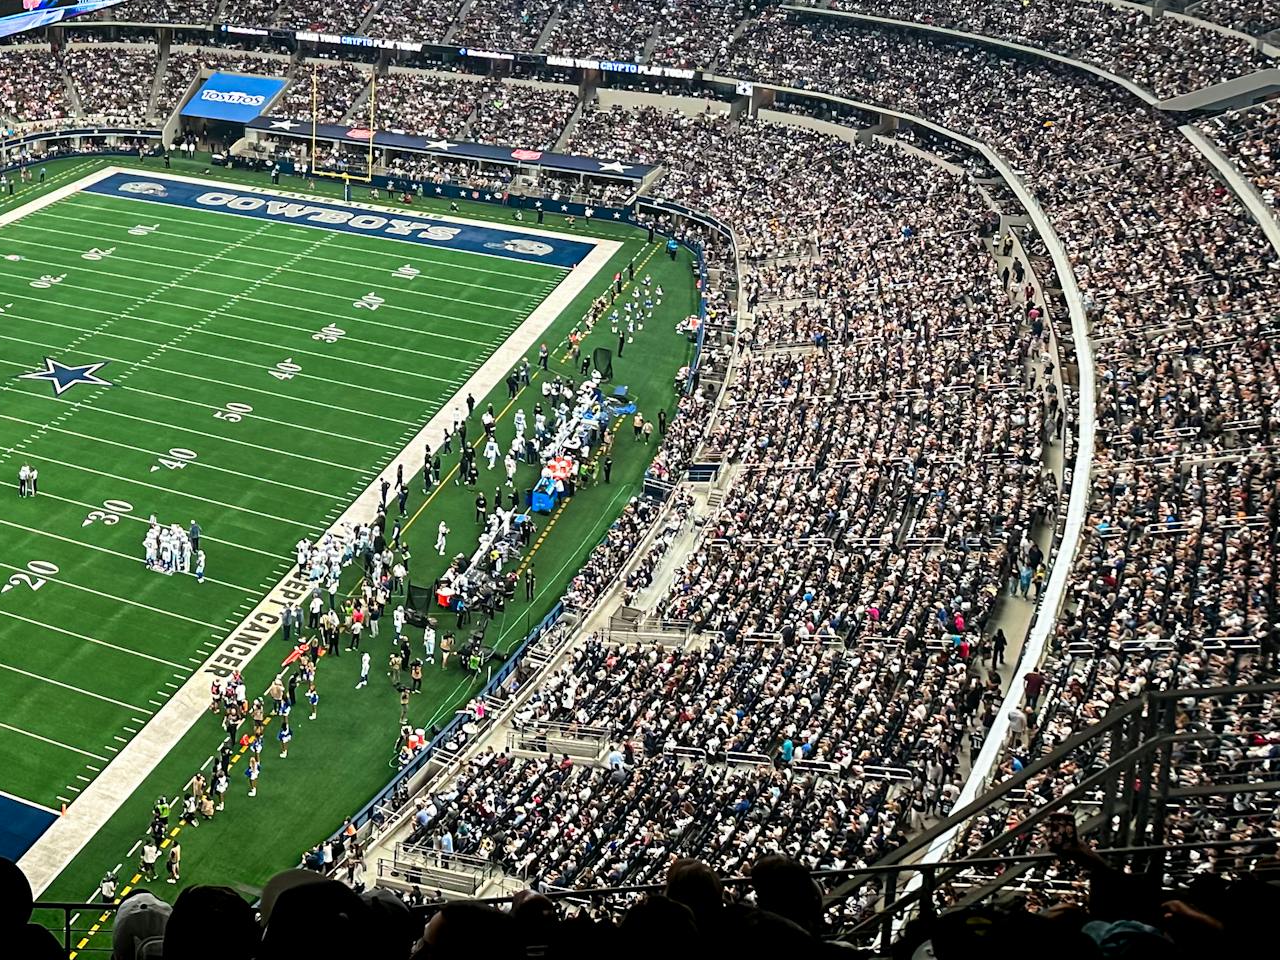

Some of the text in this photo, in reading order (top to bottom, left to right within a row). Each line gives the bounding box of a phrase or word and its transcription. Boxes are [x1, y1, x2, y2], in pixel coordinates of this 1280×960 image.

[342, 37, 373, 47] CRYPTO
[600, 61, 637, 74] CRYPTO
[638, 64, 664, 76] PLAY
[196, 192, 461, 241] COWBOYS
[127, 224, 157, 236] 10
[81, 248, 113, 261] 20
[29, 274, 63, 288] 30
[392, 267, 420, 280] 10
[352, 294, 386, 311] 20
[311, 326, 346, 344] 30
[268, 362, 302, 381] 40
[213, 402, 253, 423] 50
[157, 448, 198, 470] 40
[87, 499, 134, 525] 30
[9, 560, 59, 591] 20
[204, 613, 280, 679] CANCER
